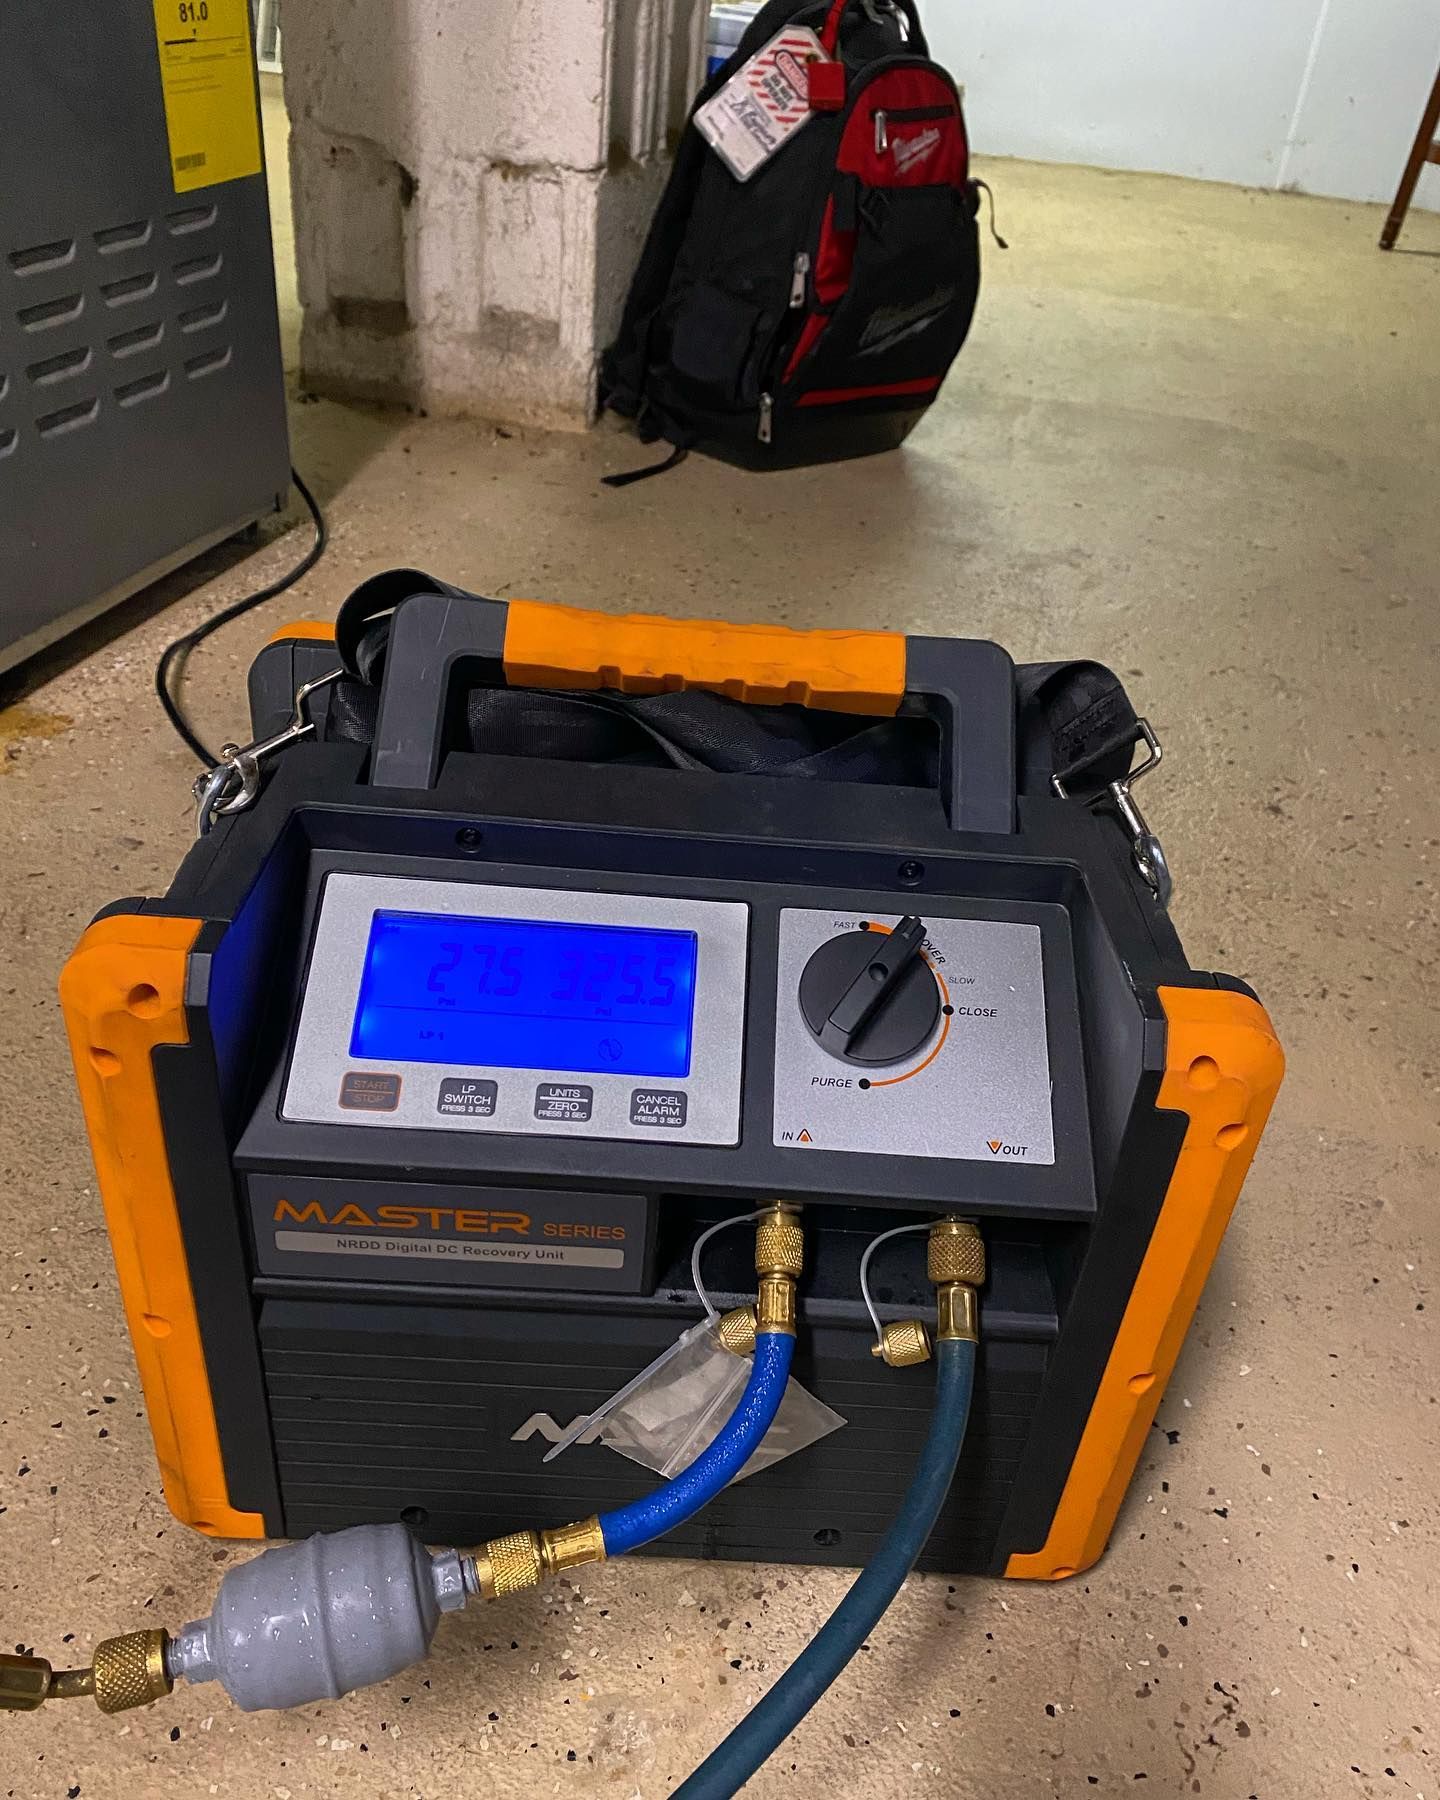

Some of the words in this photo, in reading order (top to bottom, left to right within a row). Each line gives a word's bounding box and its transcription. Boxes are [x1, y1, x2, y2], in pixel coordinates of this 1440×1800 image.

[178, 1, 208, 22] 81.0
[833, 920, 857, 929] FAST
[921, 939, 946, 965] OVER
[948, 976, 975, 985] SLOW
[958, 1006, 998, 1017] CLOSE
[353, 1080, 390, 1090] START
[811, 1077, 853, 1088] PURGE
[461, 1084, 476, 1094] LP
[549, 1088, 581, 1098] UNITS
[352, 1094, 386, 1104] STOP
[444, 1094, 491, 1105] SWITCH
[636, 1094, 681, 1106] CANCEL
[547, 1101, 580, 1111] ZERO
[637, 1105, 680, 1116] ALARM
[538, 1110, 562, 1118] PRESS
[571, 1111, 587, 1119] SEC
[634, 1115, 657, 1123] PRESS
[666, 1117, 682, 1125] SEC
[782, 1131, 794, 1141] IN
[1003, 1145, 1028, 1156] OUT
[273, 1199, 531, 1236] MASTER
[543, 1223, 626, 1240] SERIES
[337, 1239, 381, 1250] NRDD
[385, 1241, 432, 1254] Digital
[436, 1244, 458, 1254] DC
[463, 1246, 530, 1260] Recovery
[535, 1250, 565, 1260] Unit
